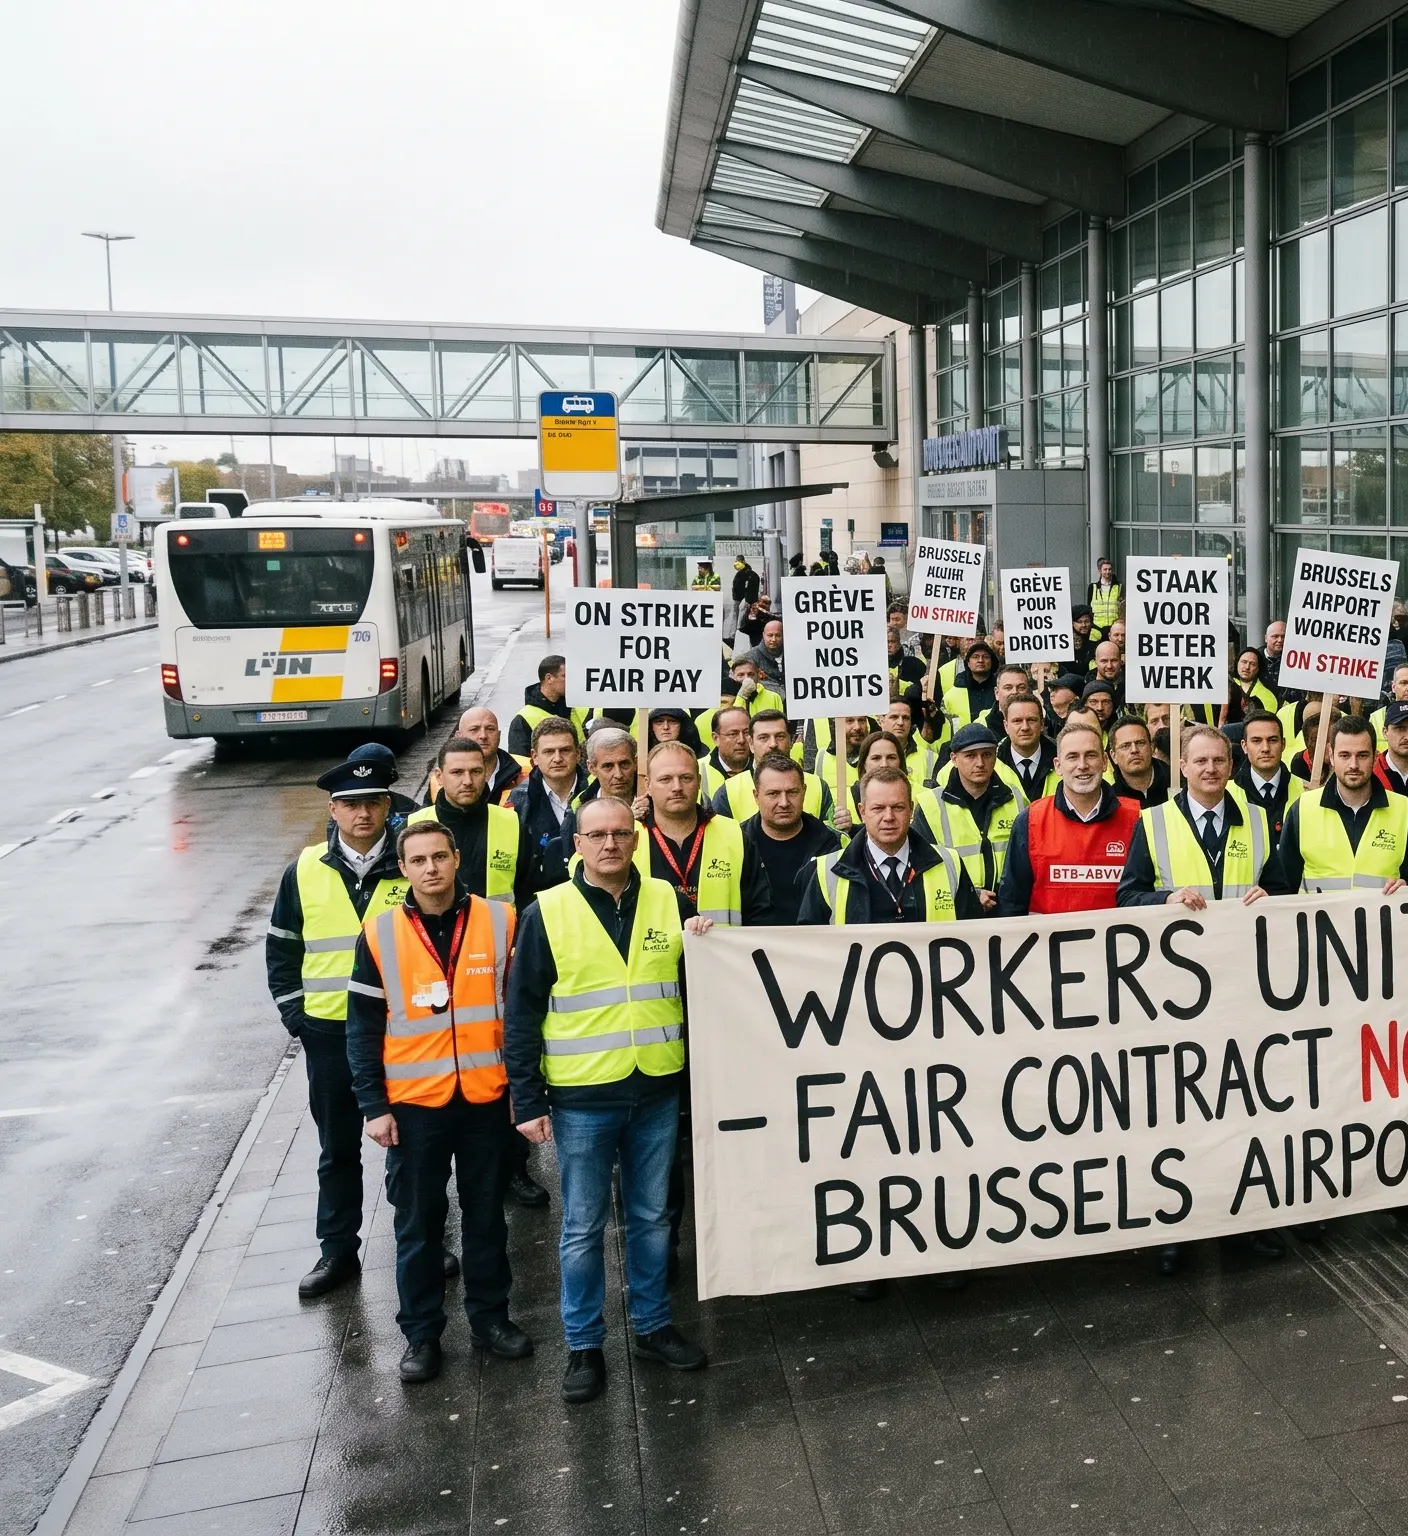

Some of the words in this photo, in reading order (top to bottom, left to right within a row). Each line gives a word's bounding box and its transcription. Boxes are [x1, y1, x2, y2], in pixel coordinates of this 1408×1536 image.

[919, 546, 981, 565] BRUSSELS
[1010, 573, 1062, 593] GRÈVE
[1137, 569, 1218, 593] STAAK
[1300, 563, 1391, 592] BRUSSELS
[795, 584, 874, 613] GRÈVE
[925, 584, 966, 601] BETER
[1017, 597, 1056, 611] POUR
[1302, 591, 1380, 617] AIRPORT
[575, 602, 610, 625] ON
[621, 603, 714, 628] STRIKE
[911, 606, 928, 619] ON
[932, 607, 975, 624] STRIKE
[1024, 616, 1052, 630] NOS
[1144, 602, 1209, 625] VOOR
[807, 620, 863, 640] POUR
[1295, 617, 1381, 646] WORKERS
[620, 636, 669, 659] FOR
[1009, 634, 1069, 651] DROITS
[1139, 634, 1215, 657] BETER
[816, 647, 858, 667] NOS
[1286, 650, 1311, 670] ON
[1316, 654, 1378, 679] STRIKE
[586, 668, 644, 692] FAIR
[655, 669, 702, 692] PAY
[793, 674, 882, 699] DROITS
[1141, 666, 1213, 689] WERK
[1053, 869, 1121, 879] BTB-ABVV
[752, 919, 1211, 1048] WORKERS
[796, 1064, 973, 1163] FAIR
[1002, 1027, 1333, 1142] CONTRACT
[815, 1148, 1192, 1266] BRUSSELS
